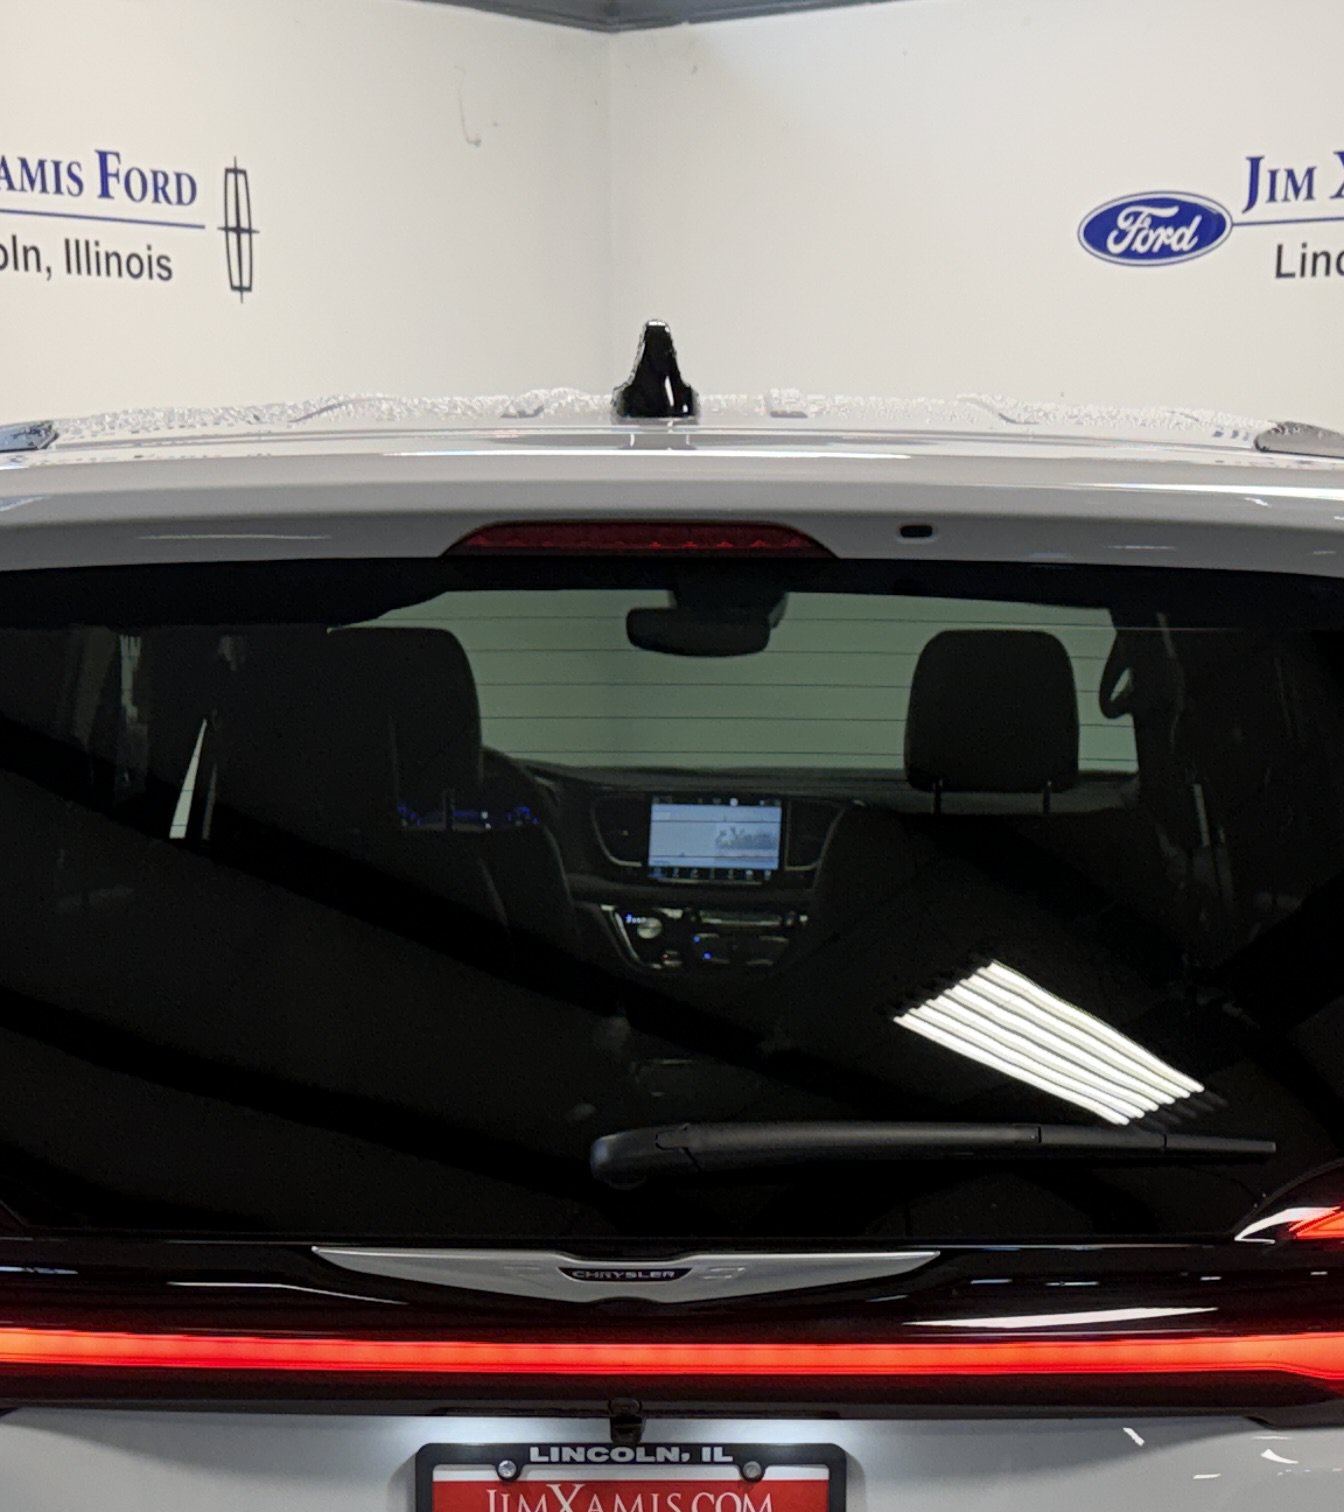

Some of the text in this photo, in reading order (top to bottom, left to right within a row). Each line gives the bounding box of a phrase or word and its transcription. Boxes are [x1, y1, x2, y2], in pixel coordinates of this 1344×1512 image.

[95, 150, 198, 206] FORD
[1242, 155, 1316, 213] JIM
[1106, 204, 1199, 254] Ford
[64, 239, 174, 282] Illinois
[572, 1270, 675, 1279] CHRYSLER
[530, 1446, 733, 1462] LINCOLN, IL
